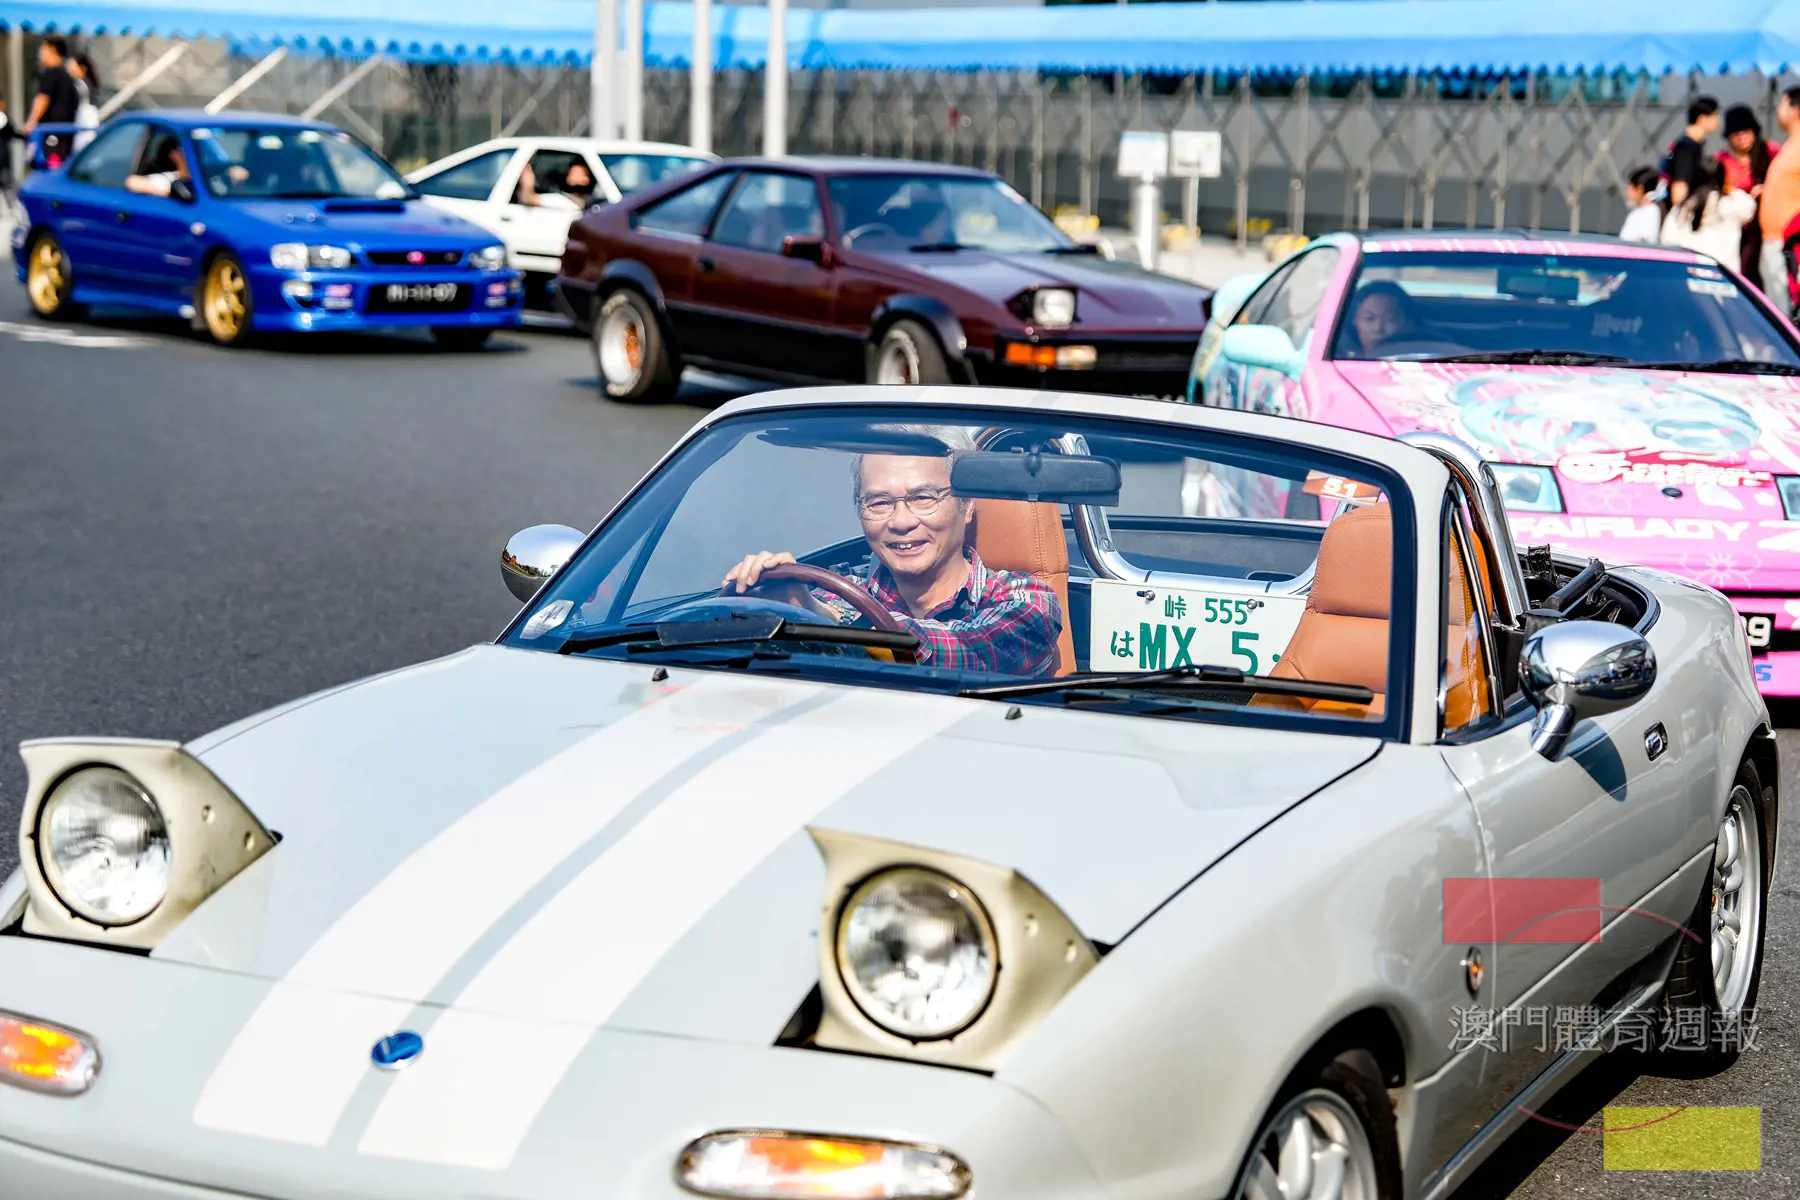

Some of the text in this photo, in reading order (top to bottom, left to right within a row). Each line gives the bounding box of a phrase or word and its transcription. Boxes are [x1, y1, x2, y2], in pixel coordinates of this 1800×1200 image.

[1507, 517, 1749, 541] FAIRLADY
[1165, 595, 1247, 625] 峠 555
[1740, 616, 1771, 647] 9
[1111, 630, 1134, 657] は
[1139, 622, 1197, 673] MX
